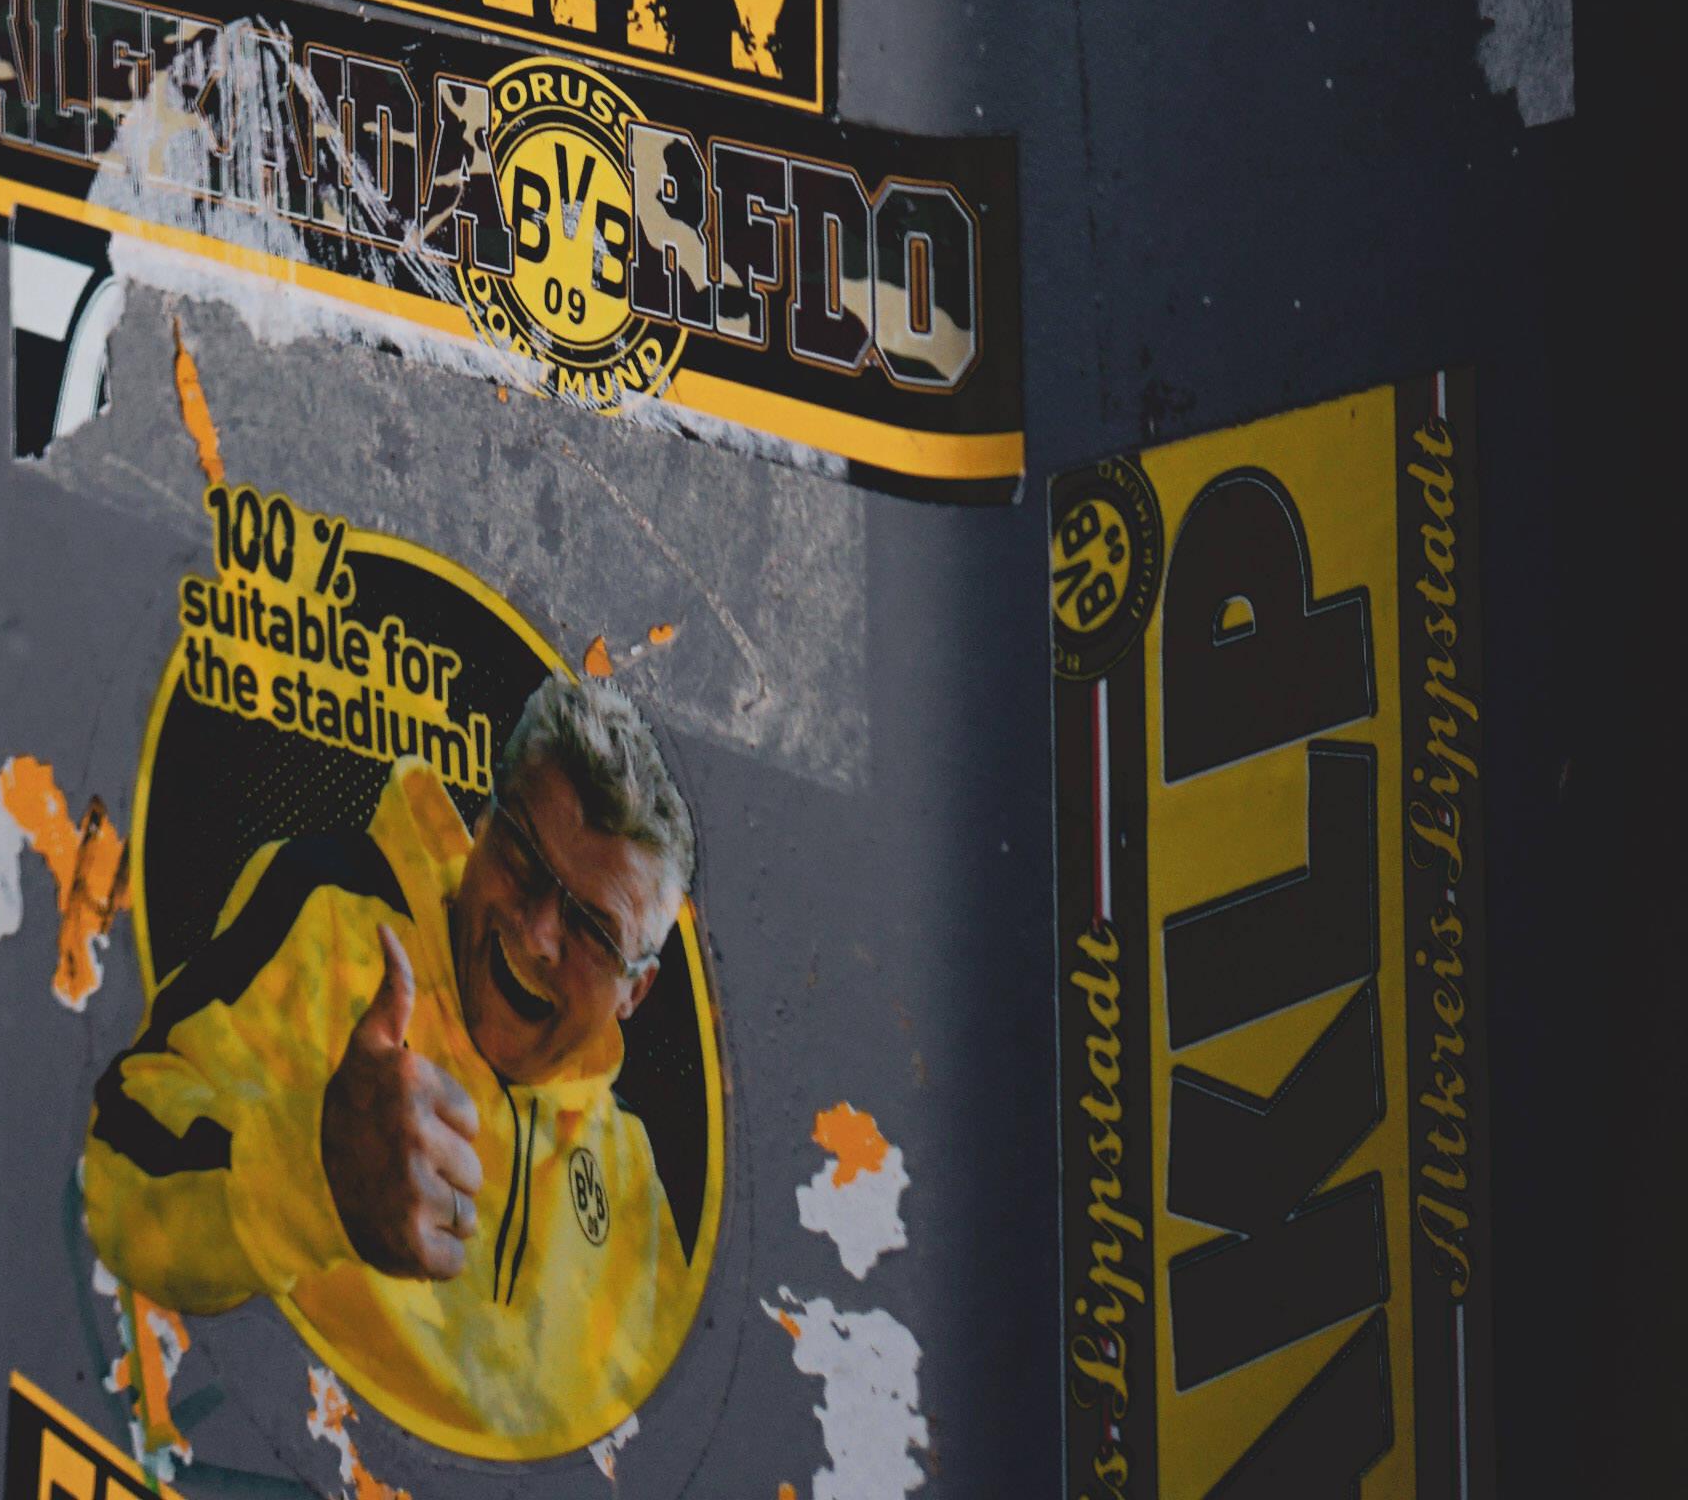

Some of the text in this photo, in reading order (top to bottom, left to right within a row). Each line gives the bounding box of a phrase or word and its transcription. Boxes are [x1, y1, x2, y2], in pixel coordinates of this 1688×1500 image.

[514, 141, 632, 300] BVB
[469, 267, 664, 402] DORMUND
[543, 276, 586, 325] 09
[208, 487, 351, 600] 100 %
[183, 578, 457, 701] suitable for
[185, 636, 489, 789] the stadium!
[1408, 415, 1480, 1299] Altkreis Lippstadt
[1071, 917, 1145, 1417] Lippstadt
